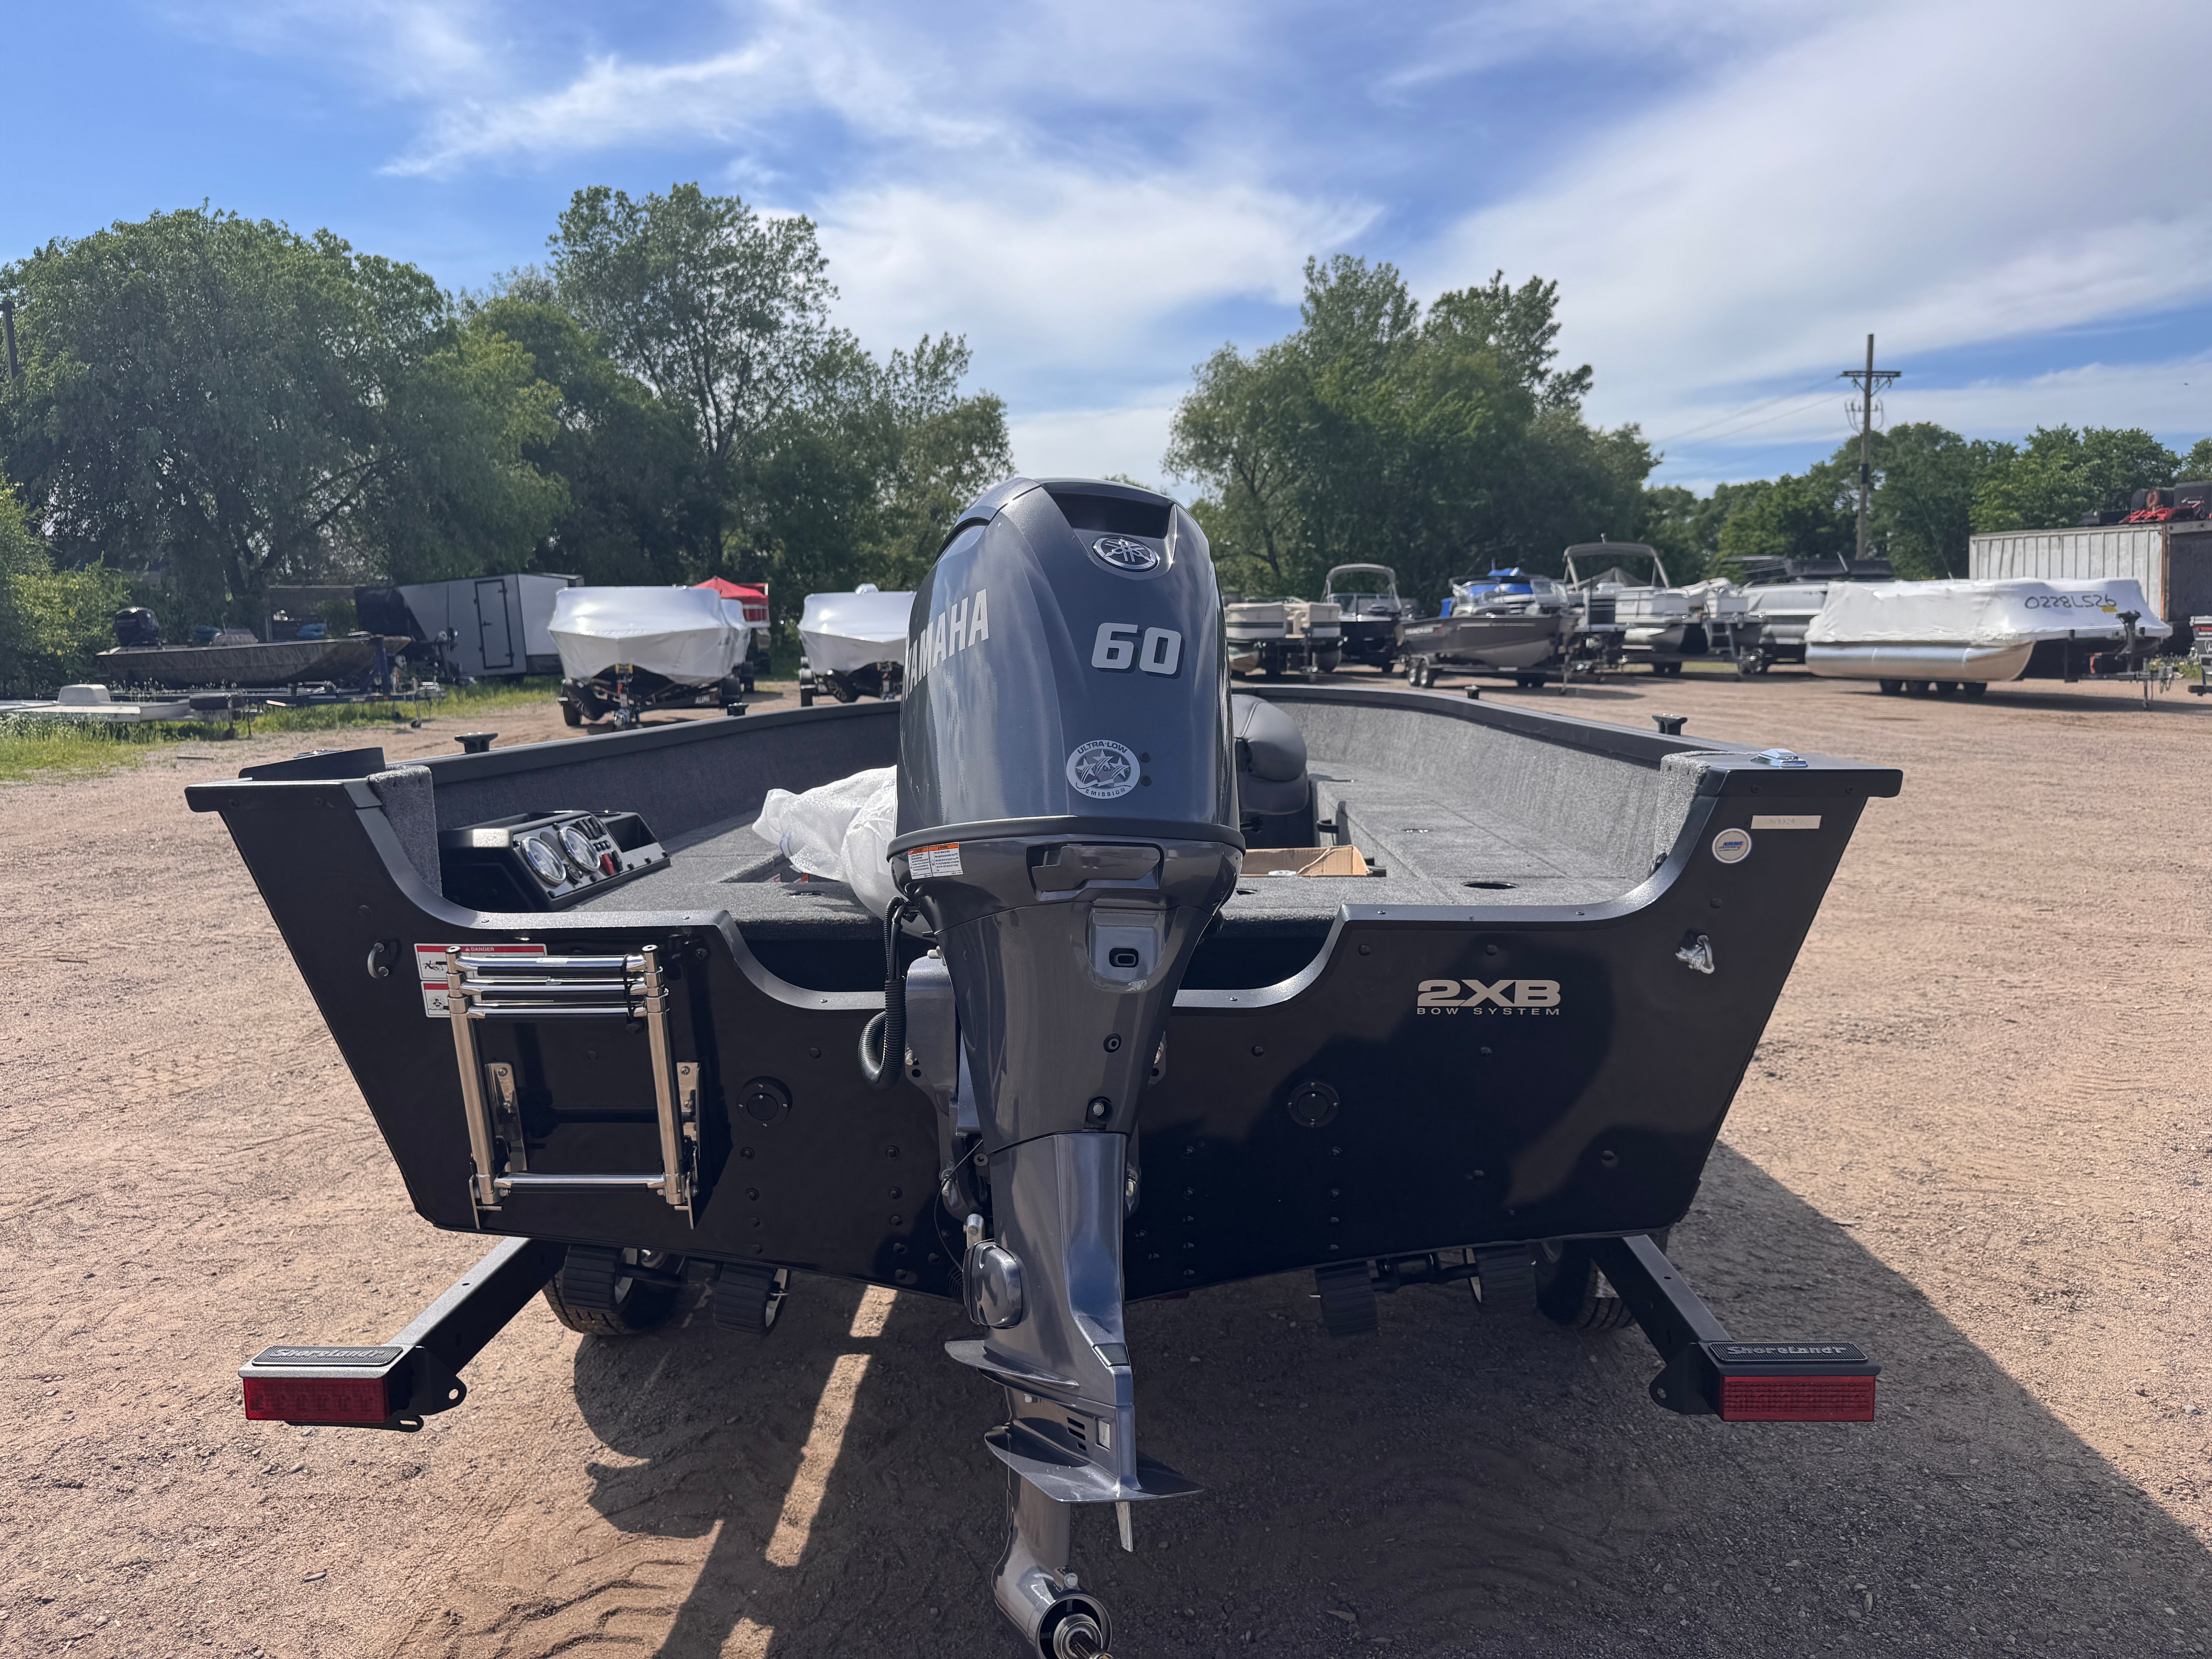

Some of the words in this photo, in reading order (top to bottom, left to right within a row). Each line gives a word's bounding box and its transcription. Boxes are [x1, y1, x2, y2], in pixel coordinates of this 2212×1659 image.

[905, 589, 989, 701] YAMAHA
[1091, 622, 1182, 675] 60
[1085, 787, 1126, 797] EMISSION
[1417, 979, 1561, 1007] 2XB
